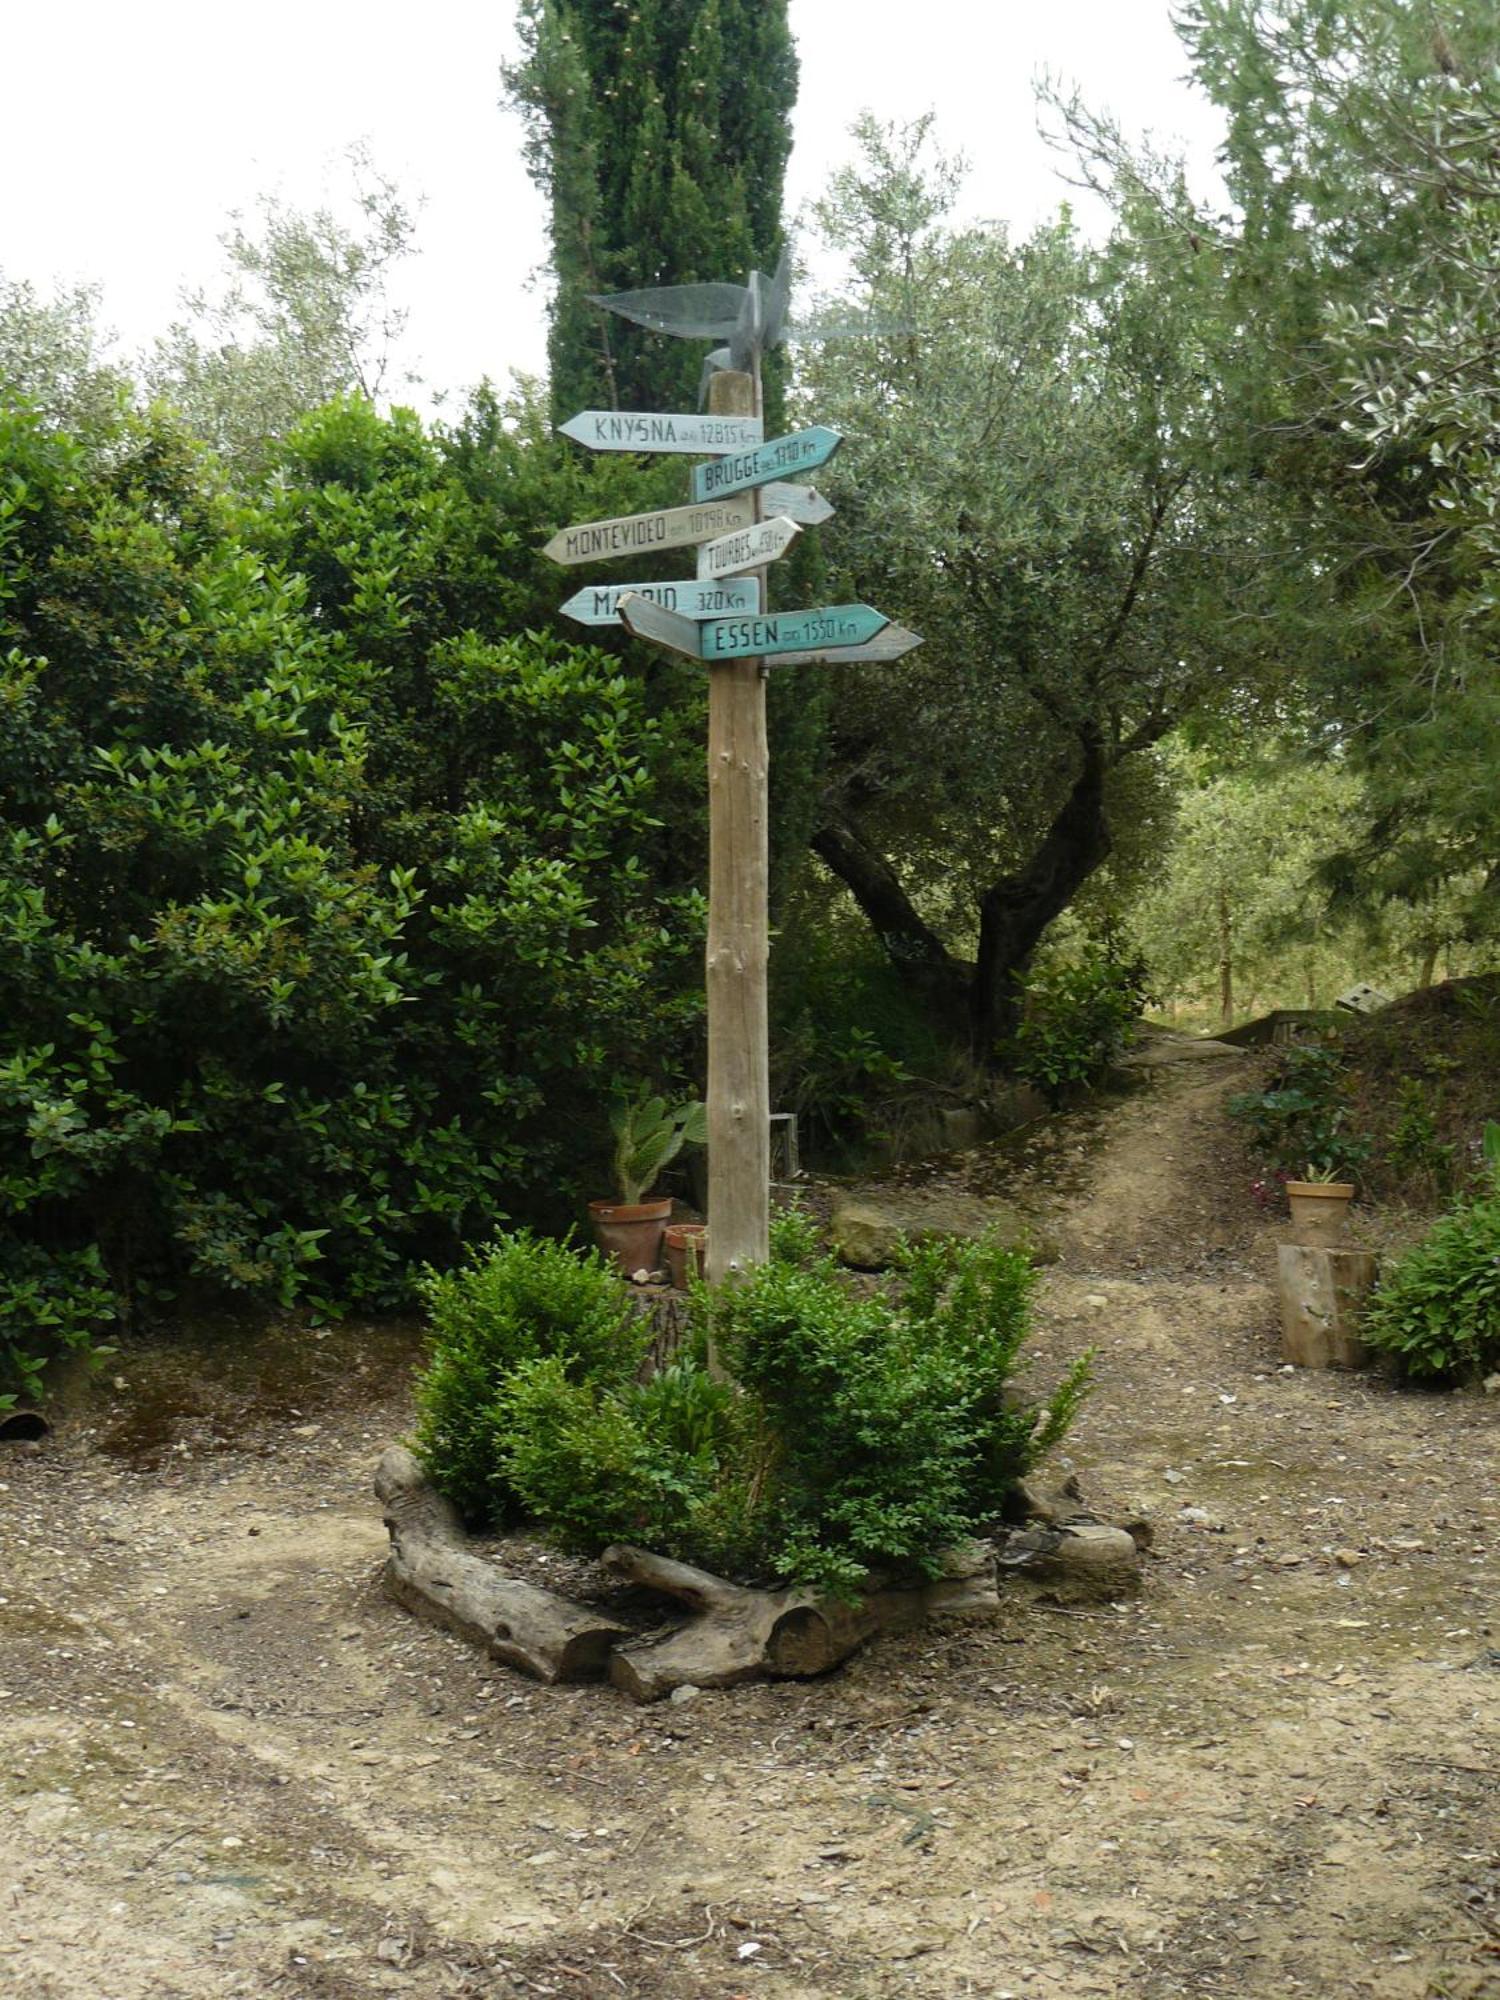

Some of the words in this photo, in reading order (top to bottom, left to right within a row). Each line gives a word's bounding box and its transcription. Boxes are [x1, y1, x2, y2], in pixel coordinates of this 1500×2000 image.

[596, 418, 677, 443] KNYSNA
[705, 452, 760, 491] BRUGGE
[566, 517, 666, 558] MONTEVIDEO
[594, 588, 677, 616] MID
[716, 620, 778, 651] ESSEN
[803, 619, 835, 641] 1550
